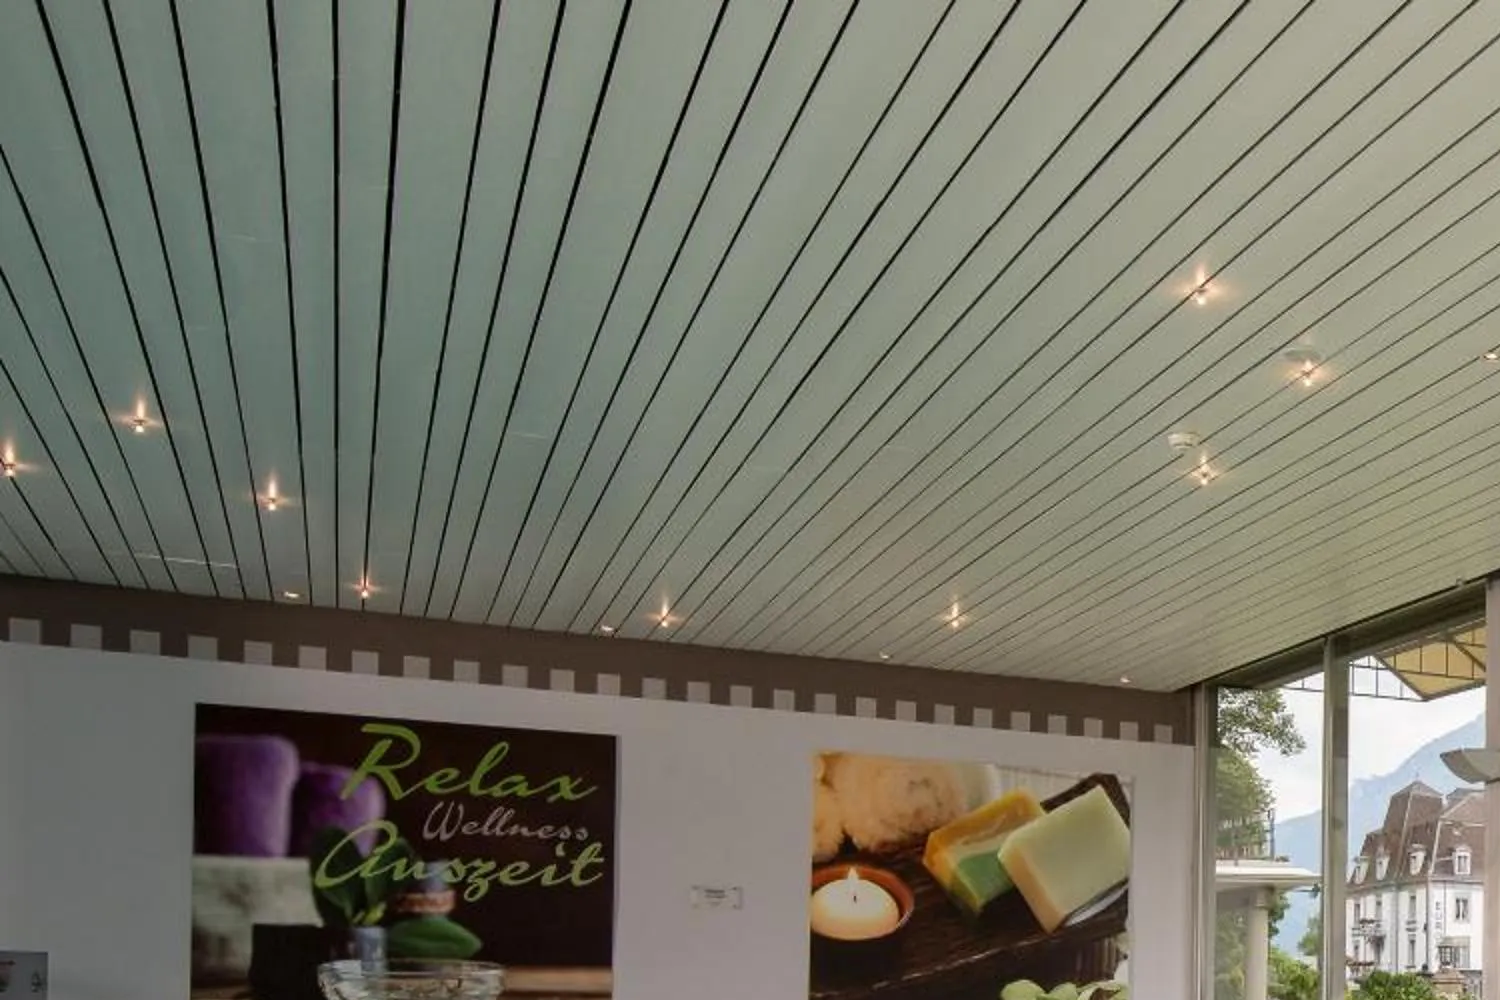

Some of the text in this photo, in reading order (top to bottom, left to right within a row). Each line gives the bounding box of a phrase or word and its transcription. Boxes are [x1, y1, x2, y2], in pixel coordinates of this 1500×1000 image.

[340, 723, 598, 803] Relax
[315, 819, 605, 902] Auszeit
[423, 800, 589, 842] Wellness
